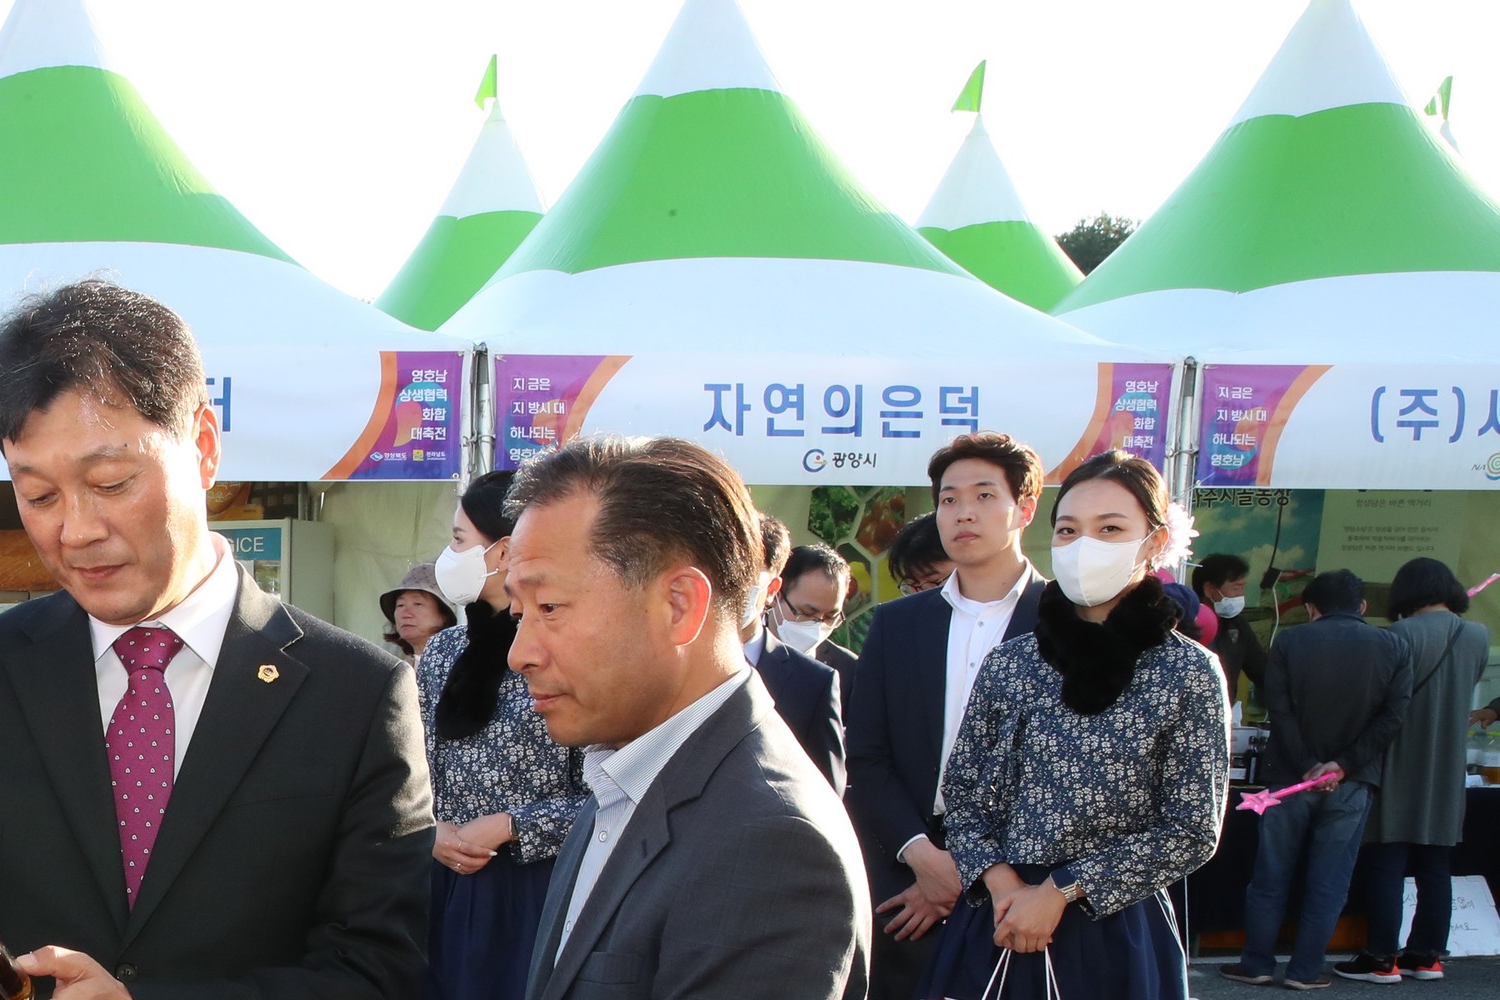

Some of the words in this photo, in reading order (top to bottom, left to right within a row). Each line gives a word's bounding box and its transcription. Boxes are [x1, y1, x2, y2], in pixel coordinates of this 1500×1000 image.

[411, 369, 448, 383] 영호남
[1125, 380, 1159, 393] 영호남
[398, 388, 448, 402] 상생협력
[703, 383, 979, 438] 자연의은덕
[1115, 398, 1157, 412] 상생협력
[421, 407, 447, 421] 화합
[1133, 417, 1155, 430] 화합
[410, 427, 447, 440] 대축전
[509, 426, 556, 439] 하나되는
[1122, 435, 1154, 448] 대축전
[1212, 433, 1257, 446] 하나되는
[832, 451, 877, 469] 광양시
[1210, 454, 1245, 466] 영호남
